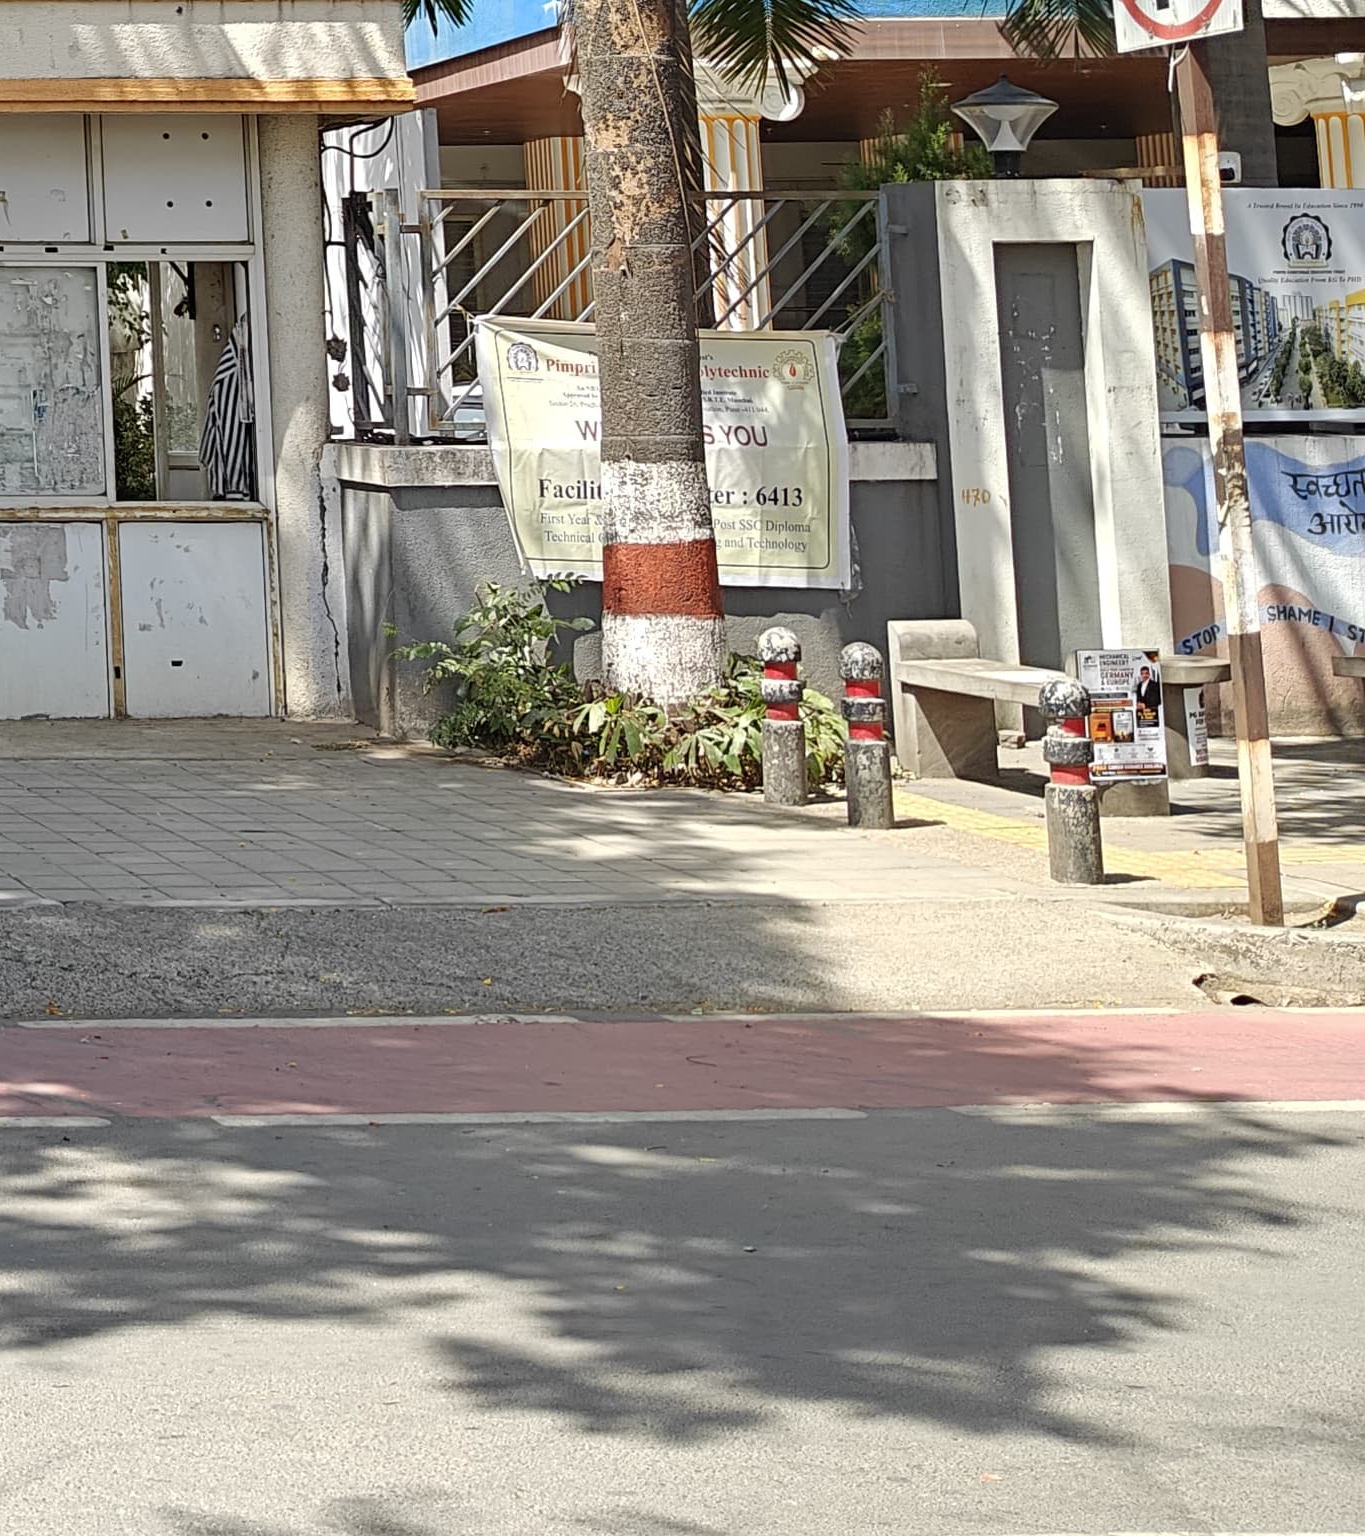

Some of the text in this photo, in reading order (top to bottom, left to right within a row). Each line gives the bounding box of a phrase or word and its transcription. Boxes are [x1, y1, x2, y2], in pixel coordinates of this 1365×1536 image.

[546, 358, 596, 376] Pimpri
[719, 425, 768, 447] YOU
[538, 478, 602, 500] Facilit
[755, 486, 803, 507] 6413
[1281, 469, 1365, 500] स्वच्छत
[541, 512, 564, 524] First
[568, 513, 590, 526] Year
[714, 518, 736, 530] Post
[739, 519, 761, 531] SSC
[765, 520, 811, 534] Diploma
[1307, 500, 1365, 535] आरो
[544, 530, 595, 543] Technical
[725, 539, 743, 549] and
[747, 537, 807, 552] Technology
[1182, 624, 1221, 655] STOP
[1267, 605, 1320, 626] SHAME
